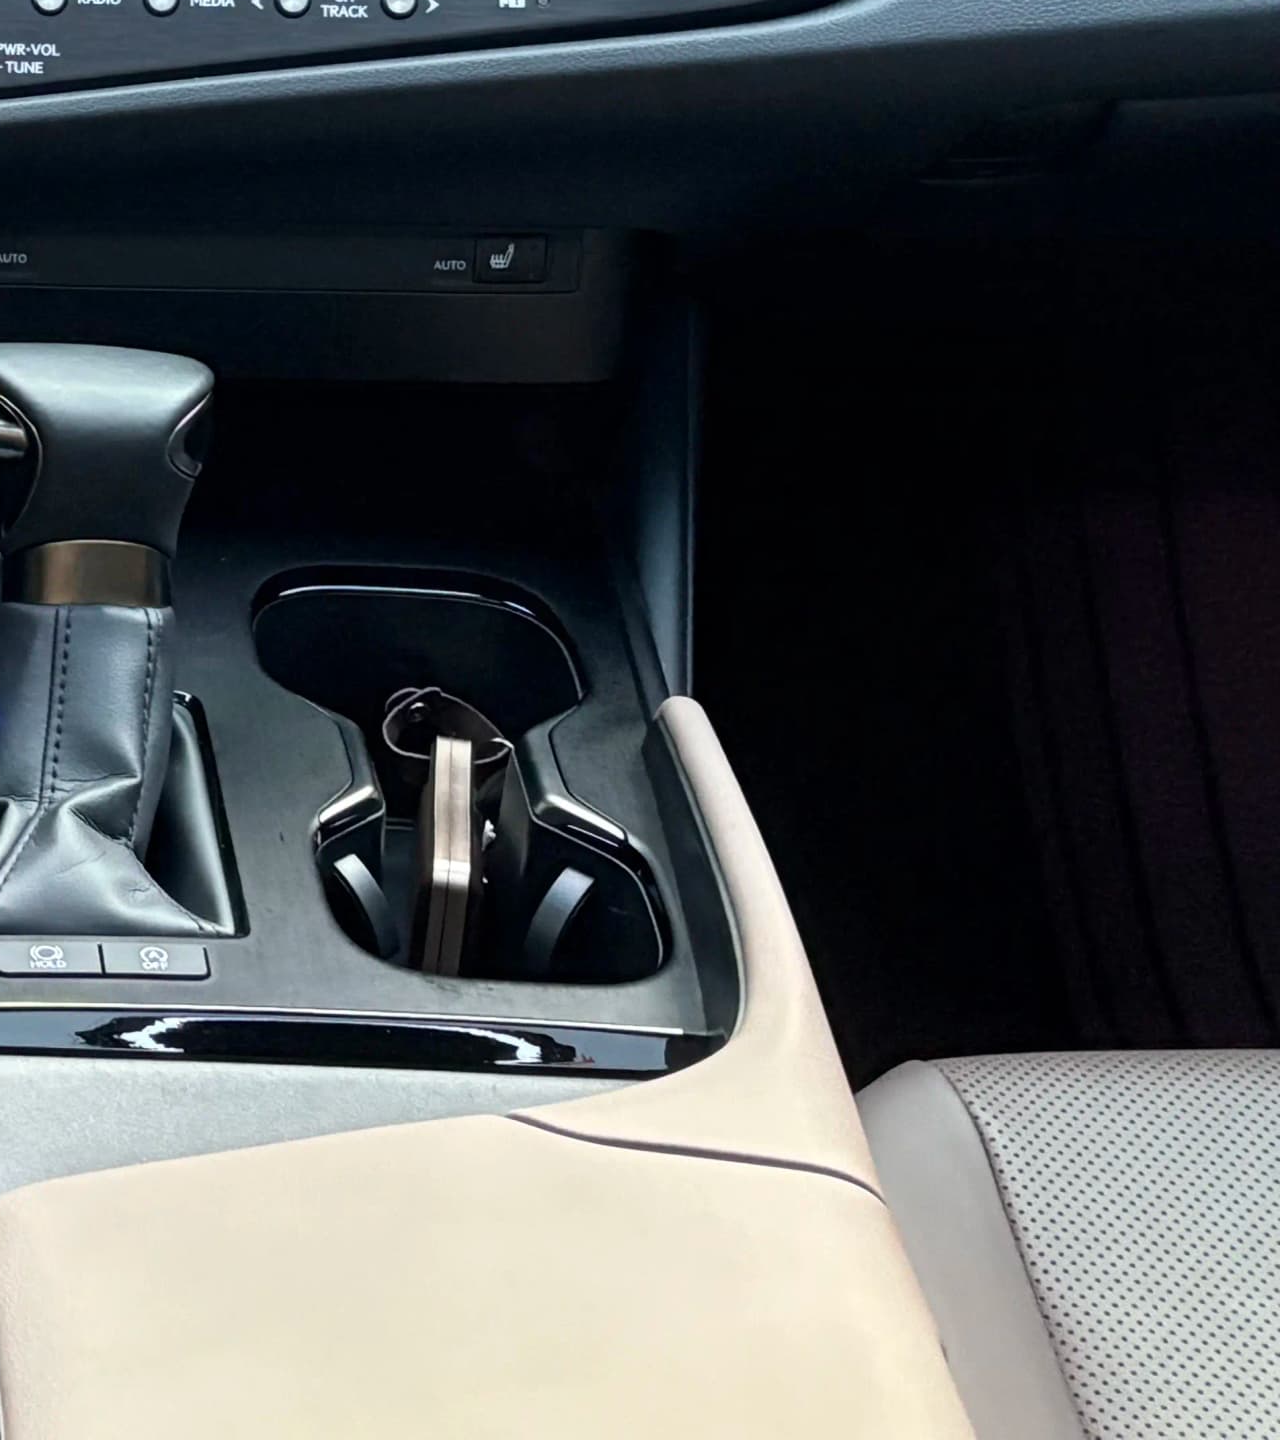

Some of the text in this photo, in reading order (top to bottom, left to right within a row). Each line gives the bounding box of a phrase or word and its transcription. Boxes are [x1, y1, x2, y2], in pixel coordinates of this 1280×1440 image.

[320, 4, 369, 19] TRACK
[5, 61, 45, 75] TUNE
[434, 260, 467, 271] AUTO
[30, 959, 67, 970] HOLD
[142, 961, 168, 972] OFF
